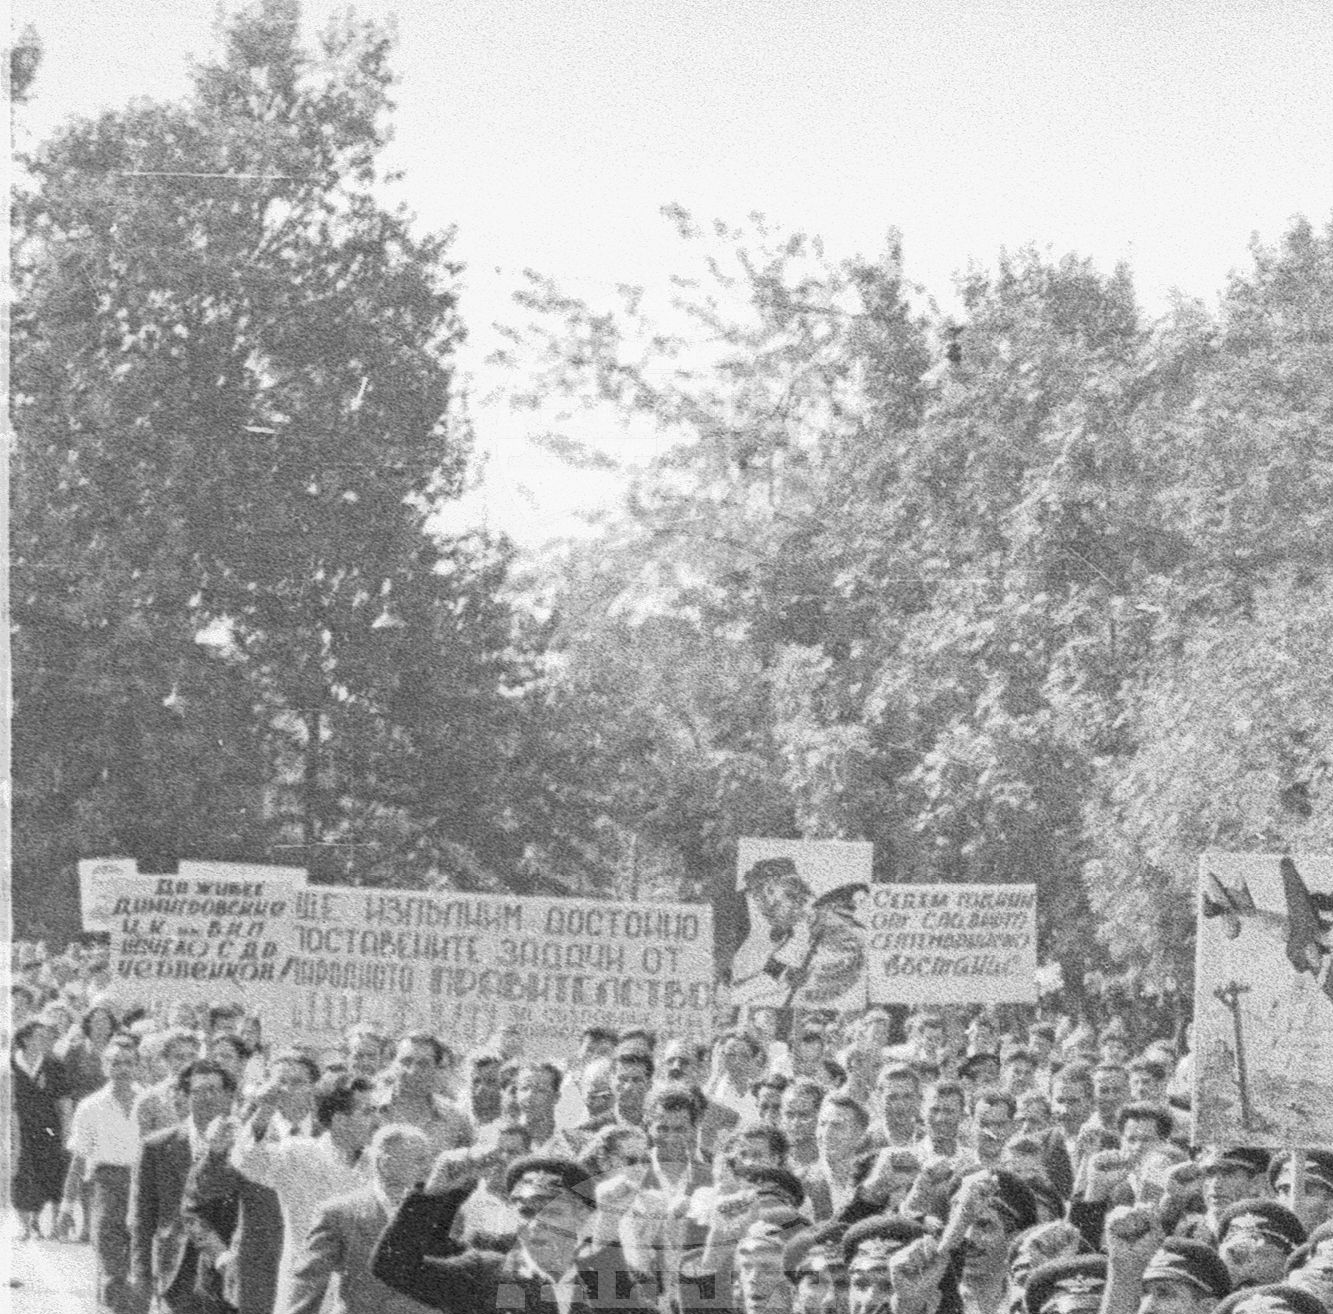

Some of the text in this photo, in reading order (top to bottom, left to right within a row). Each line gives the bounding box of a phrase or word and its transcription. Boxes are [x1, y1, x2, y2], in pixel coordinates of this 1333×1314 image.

[498, 938, 625, 975] ЗАДАЧИ
[642, 946, 680, 977] ОТ
[429, 966, 712, 1013] ПРАВИТЕЛСТВО
